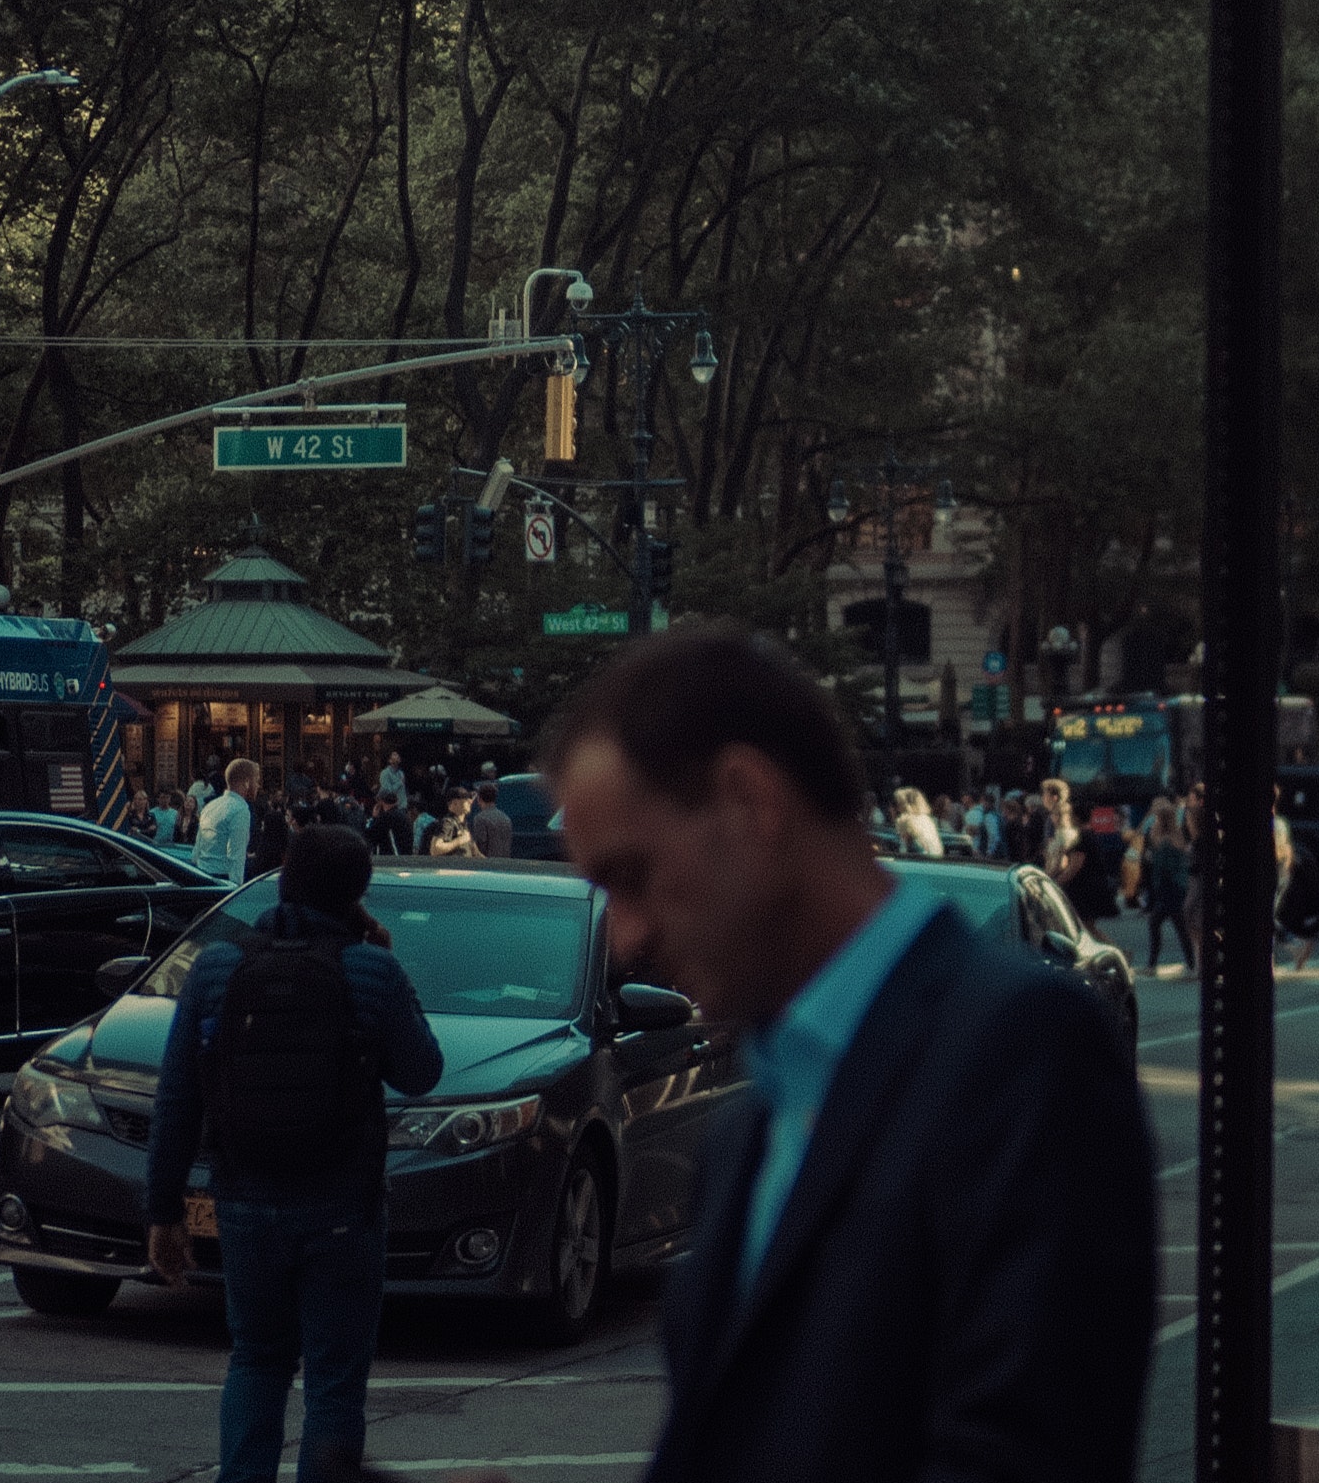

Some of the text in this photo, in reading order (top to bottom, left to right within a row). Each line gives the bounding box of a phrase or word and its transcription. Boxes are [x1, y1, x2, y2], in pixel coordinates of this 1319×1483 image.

[267, 435, 355, 460] W 42 St
[548, 616, 582, 632] West
